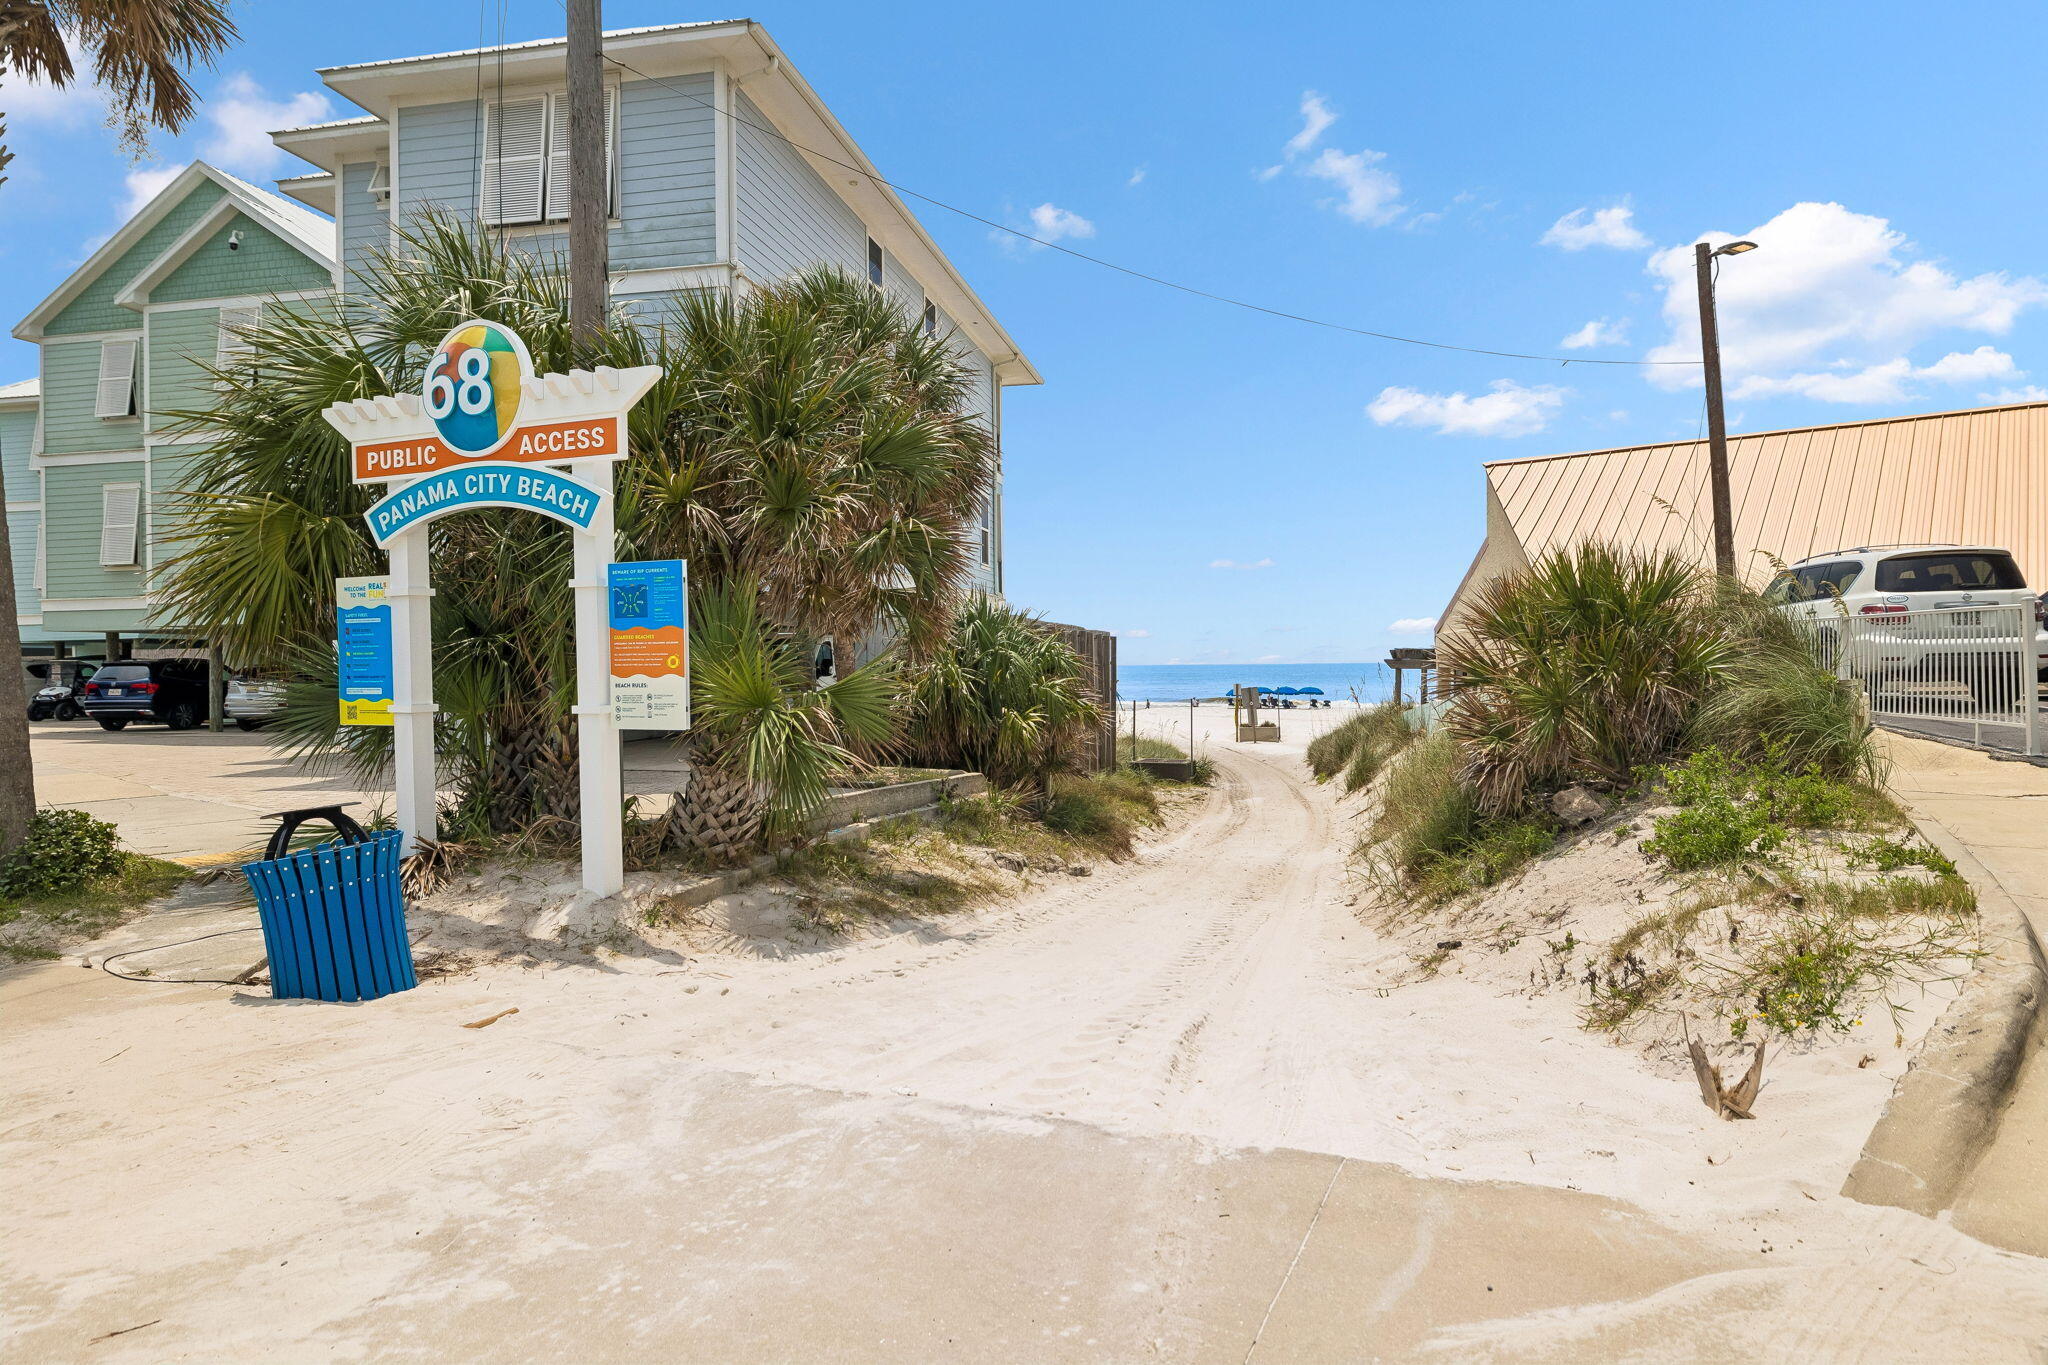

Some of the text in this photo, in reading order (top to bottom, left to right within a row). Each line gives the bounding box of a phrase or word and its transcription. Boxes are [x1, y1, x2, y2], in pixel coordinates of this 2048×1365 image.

[422, 348, 493, 420] 68
[366, 426, 605, 471] PUBLIC ACCESS
[377, 473, 590, 533] PANAMA CITY BEACH
[368, 582, 383, 590] REAL
